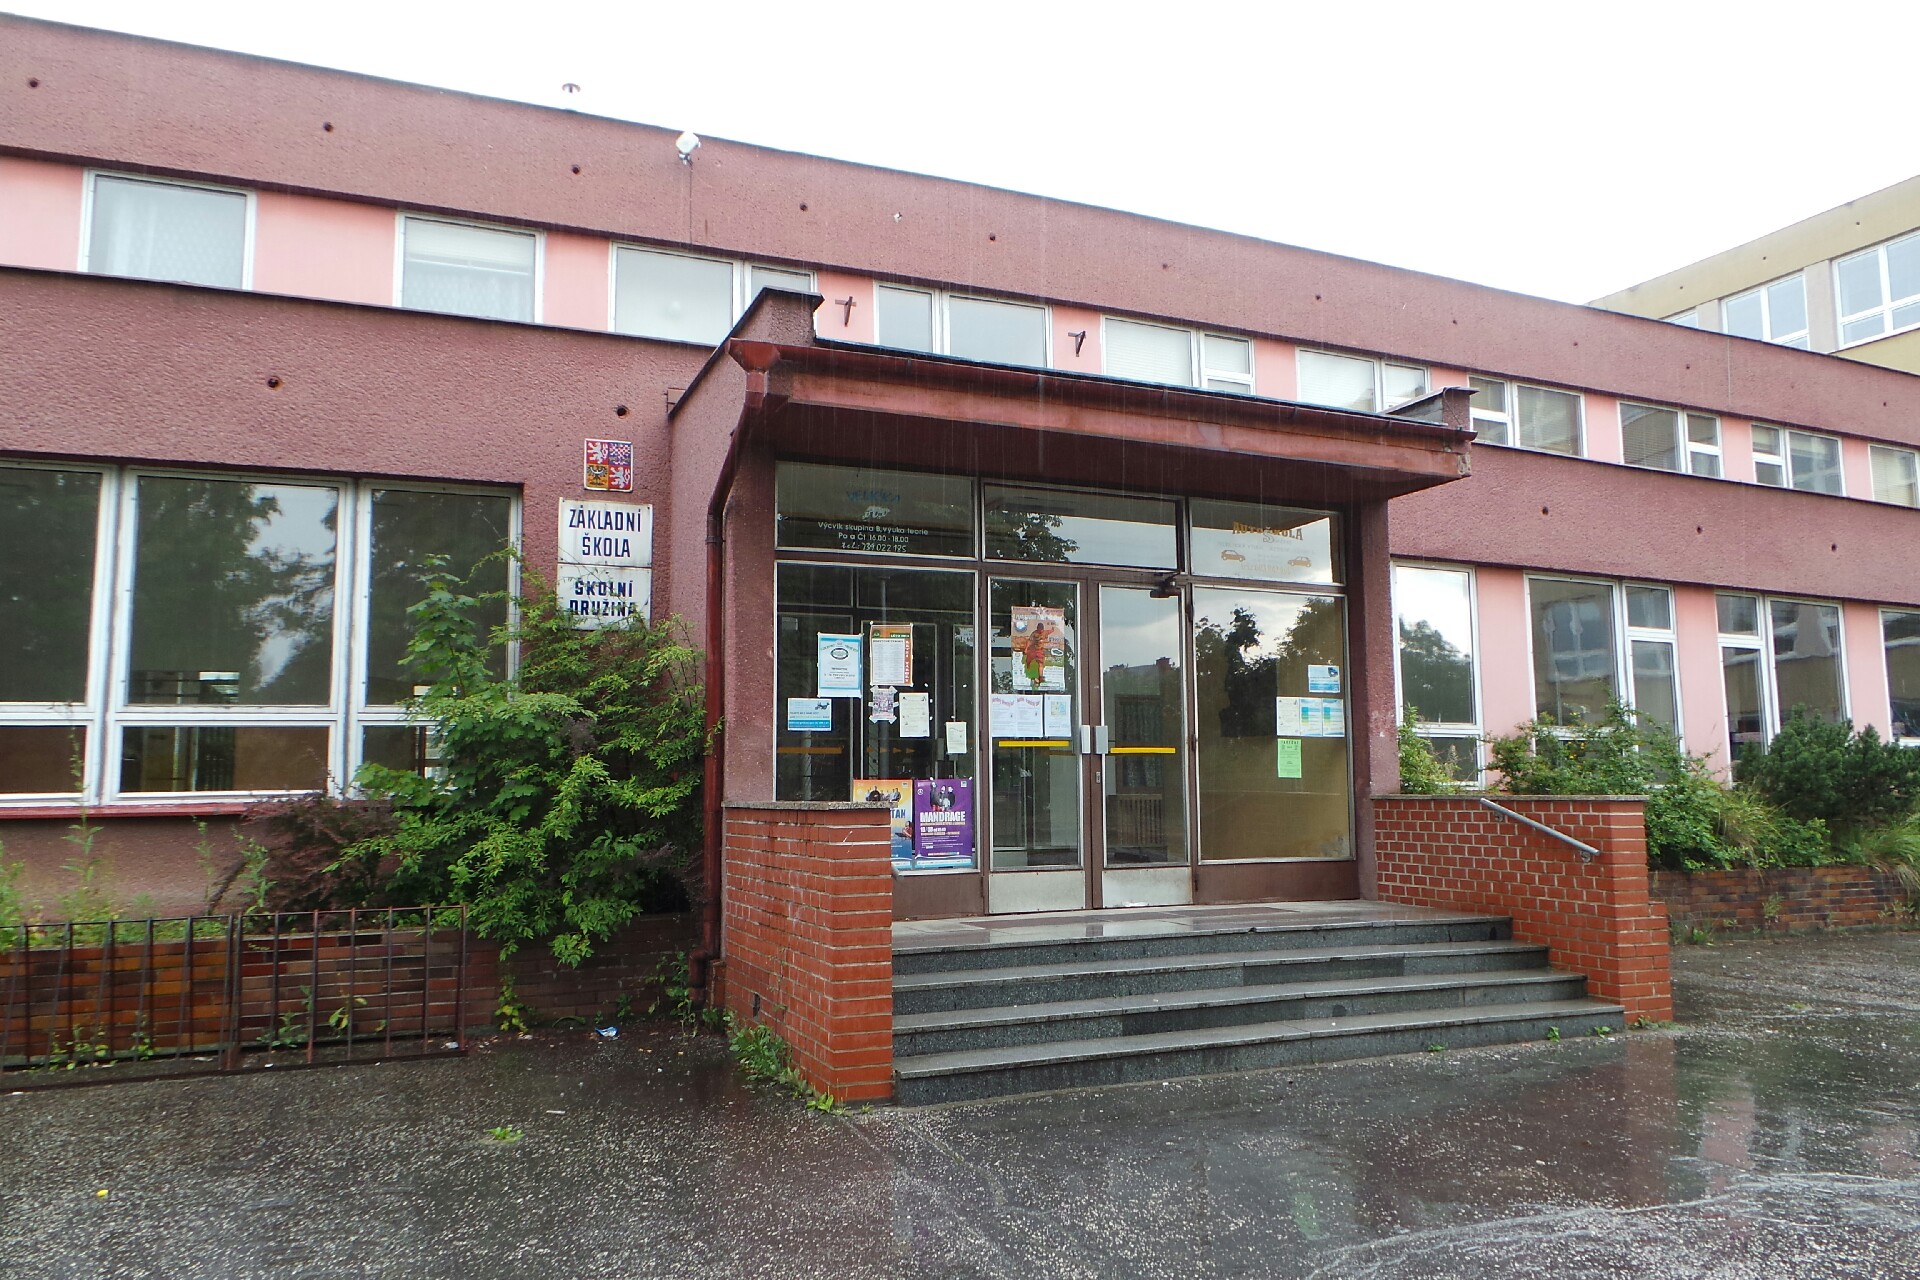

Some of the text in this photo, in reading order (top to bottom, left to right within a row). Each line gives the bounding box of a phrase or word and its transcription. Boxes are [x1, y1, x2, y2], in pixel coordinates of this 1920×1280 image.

[568, 505, 642, 533] ZÁKLADNÍ
[817, 521, 843, 530] Výcvik
[845, 523, 874, 532] skupina
[838, 532, 848, 540] Po
[582, 532, 631, 557] ŠKOLA
[574, 577, 634, 597] ŠKOLNÍ
[919, 811, 966, 823] MANDRAGE
